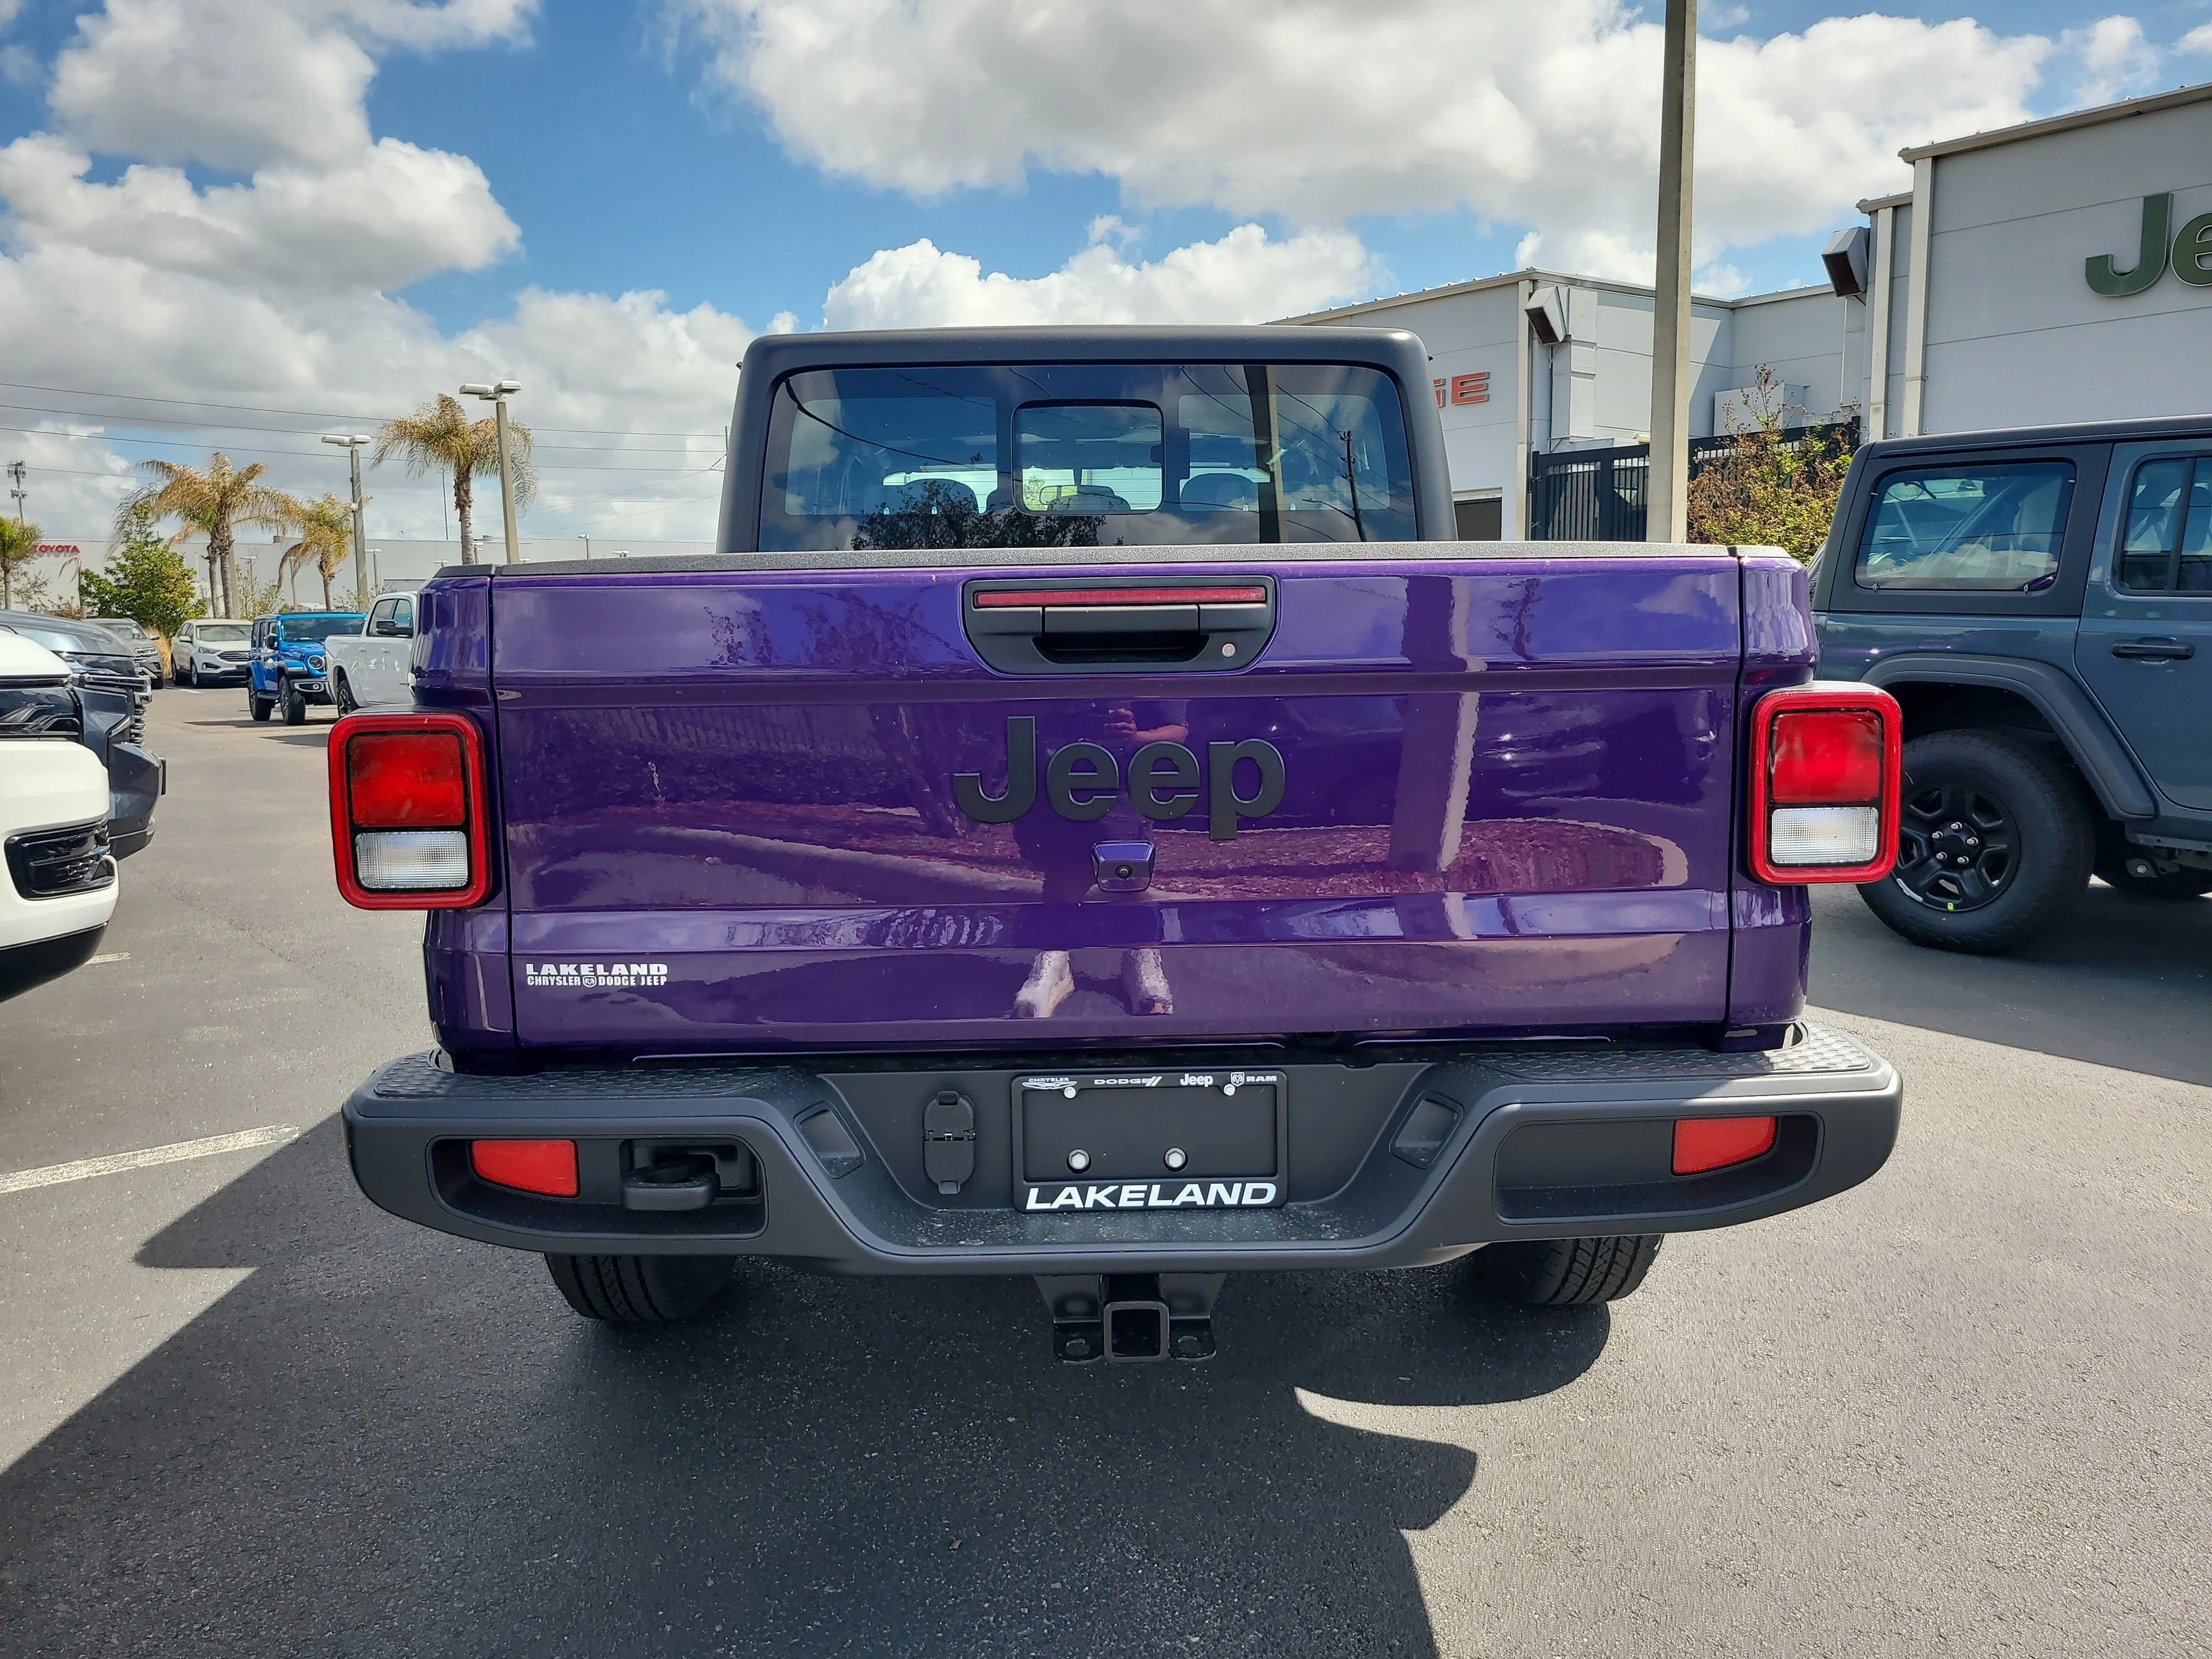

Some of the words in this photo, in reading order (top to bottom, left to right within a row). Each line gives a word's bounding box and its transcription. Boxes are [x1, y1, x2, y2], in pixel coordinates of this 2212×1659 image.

[32, 544, 81, 553] TOYOTA
[953, 715, 1285, 841] Jeep
[526, 963, 668, 975] LAKELAND
[527, 975, 581, 986] CHRYSLER
[598, 975, 636, 986] DODGE
[640, 975, 667, 986] JEEP
[1180, 1073, 1214, 1087] Jeep
[1025, 1183, 1277, 1210] LAKELAND
